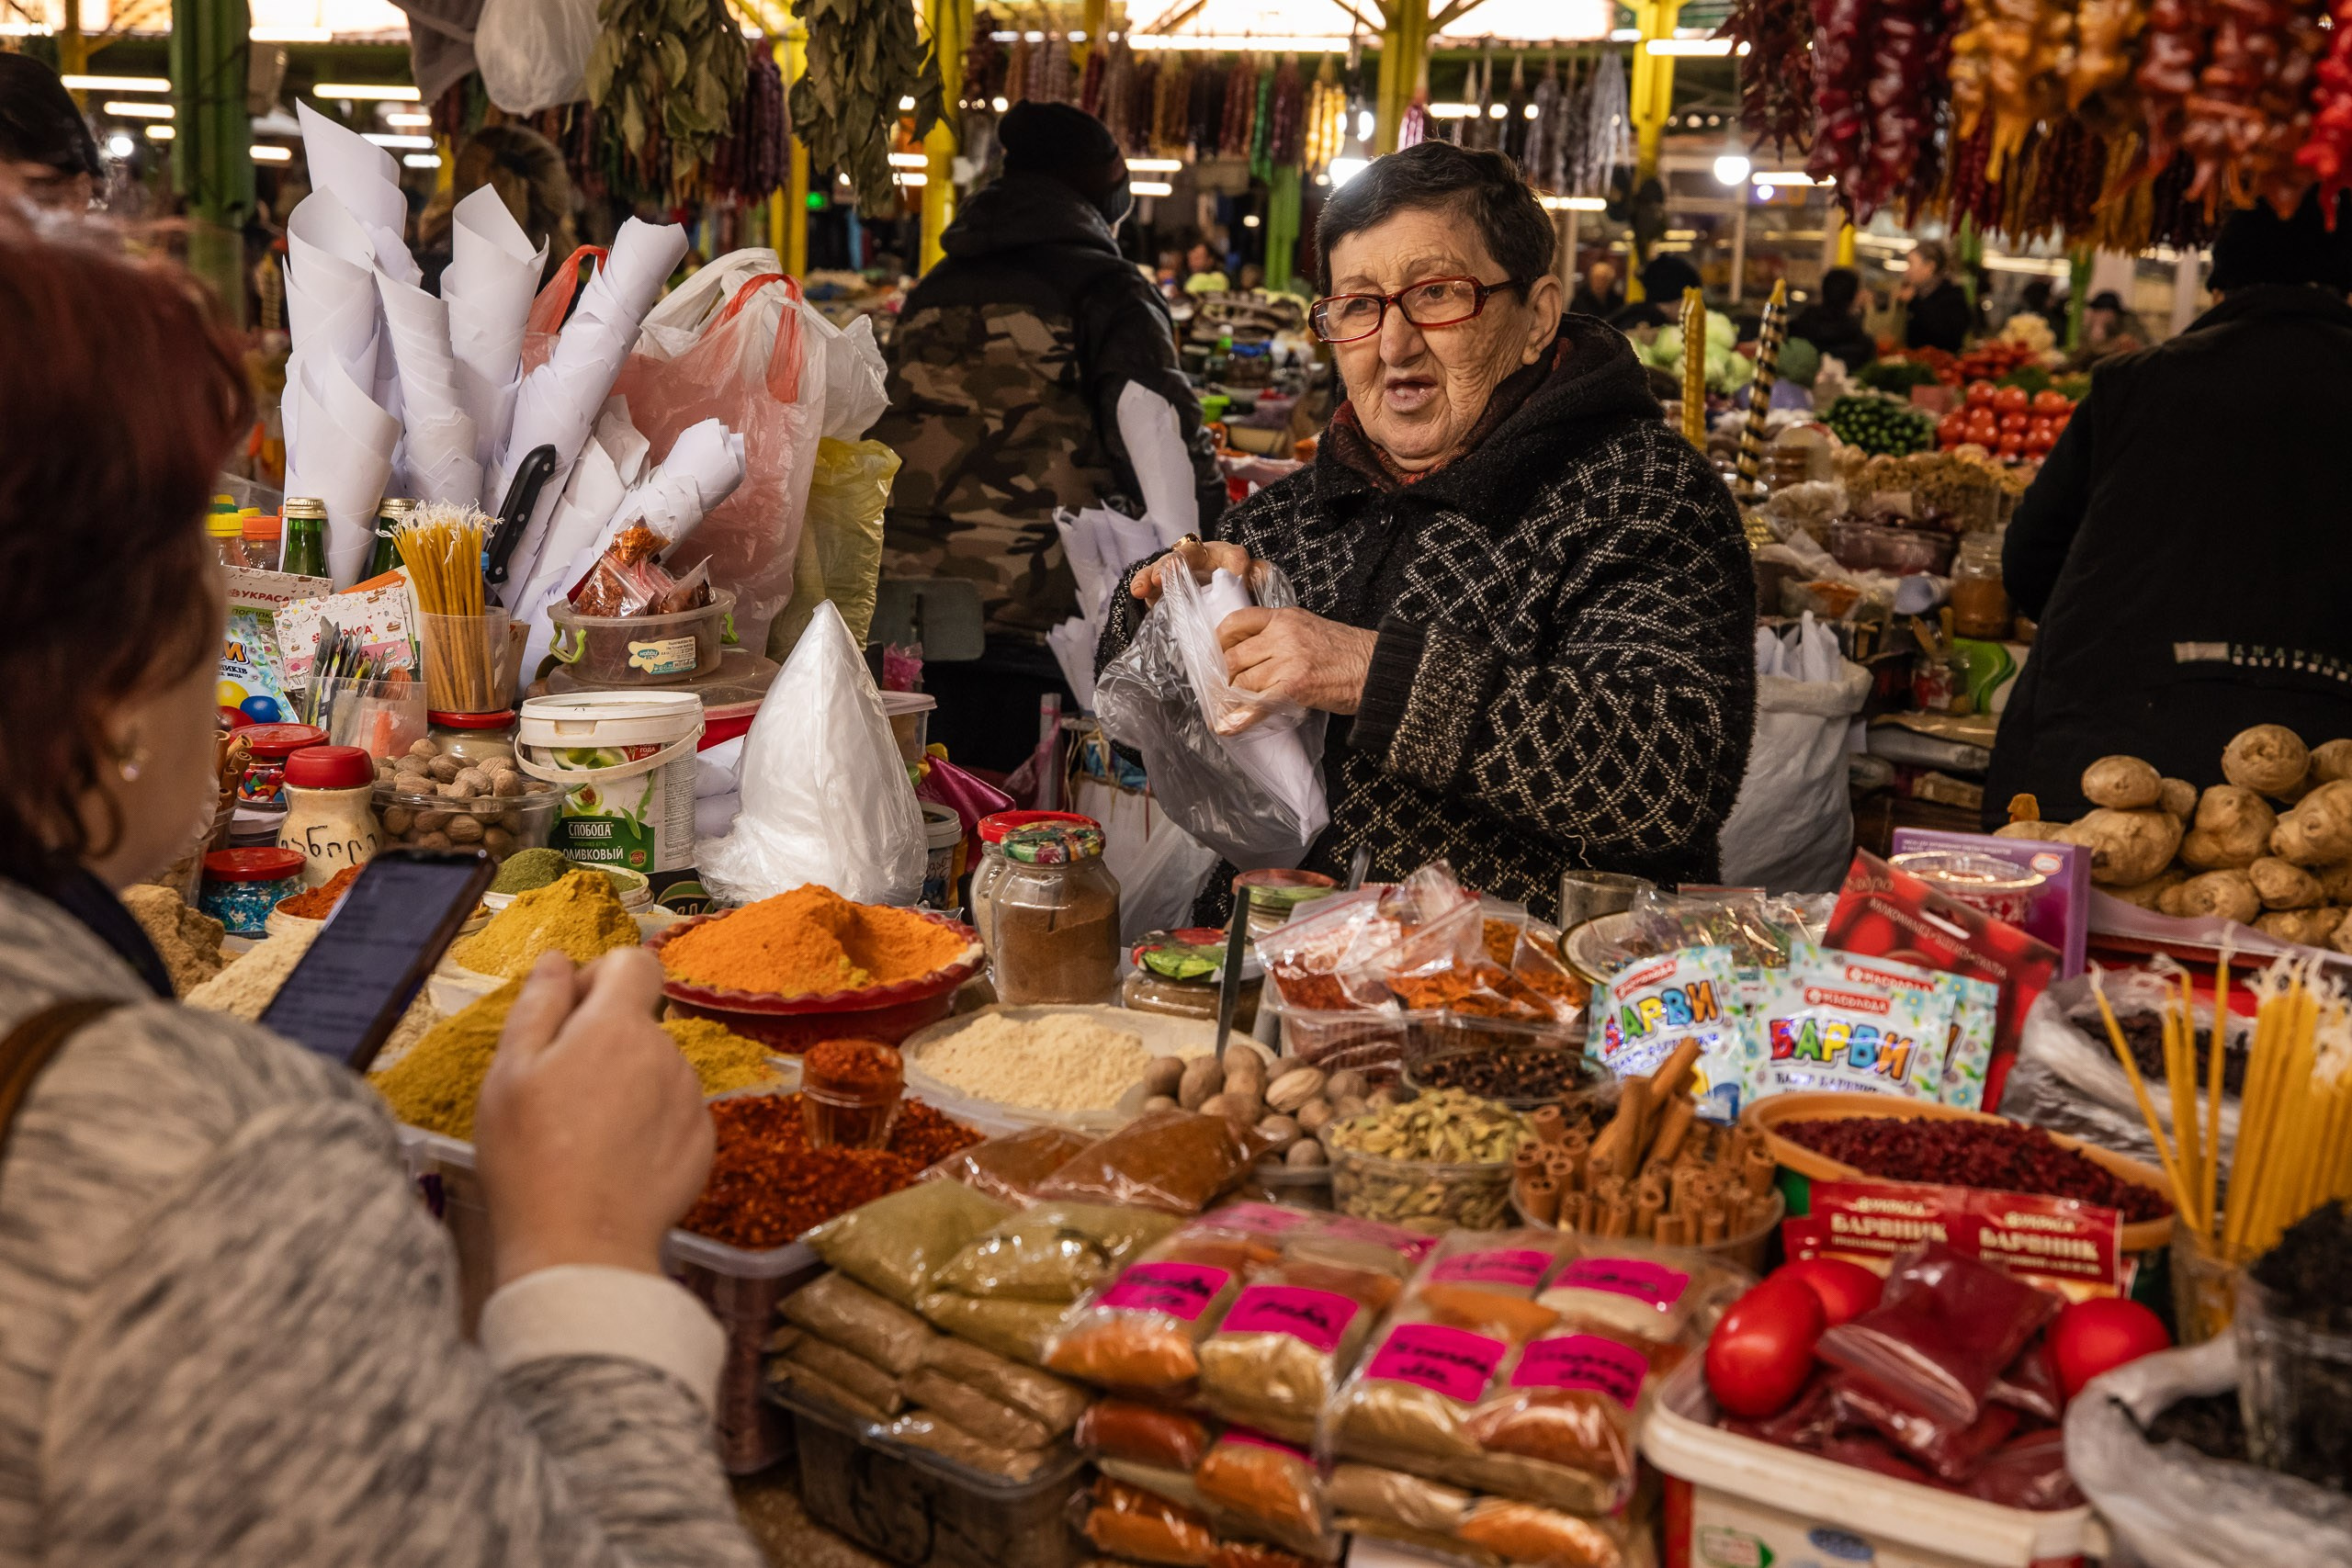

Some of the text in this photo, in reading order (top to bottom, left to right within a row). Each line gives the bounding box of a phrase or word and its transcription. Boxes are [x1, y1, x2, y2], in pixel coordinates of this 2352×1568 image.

[242, 591, 290, 603] УКРАСА
[569, 823, 612, 837] СЛОБОДА
[563, 845, 624, 861] ОЛИВКОВЫЙ
[1604, 979, 1718, 1055] БАРВИ
[1770, 1017, 1914, 1080] БАРВИ
